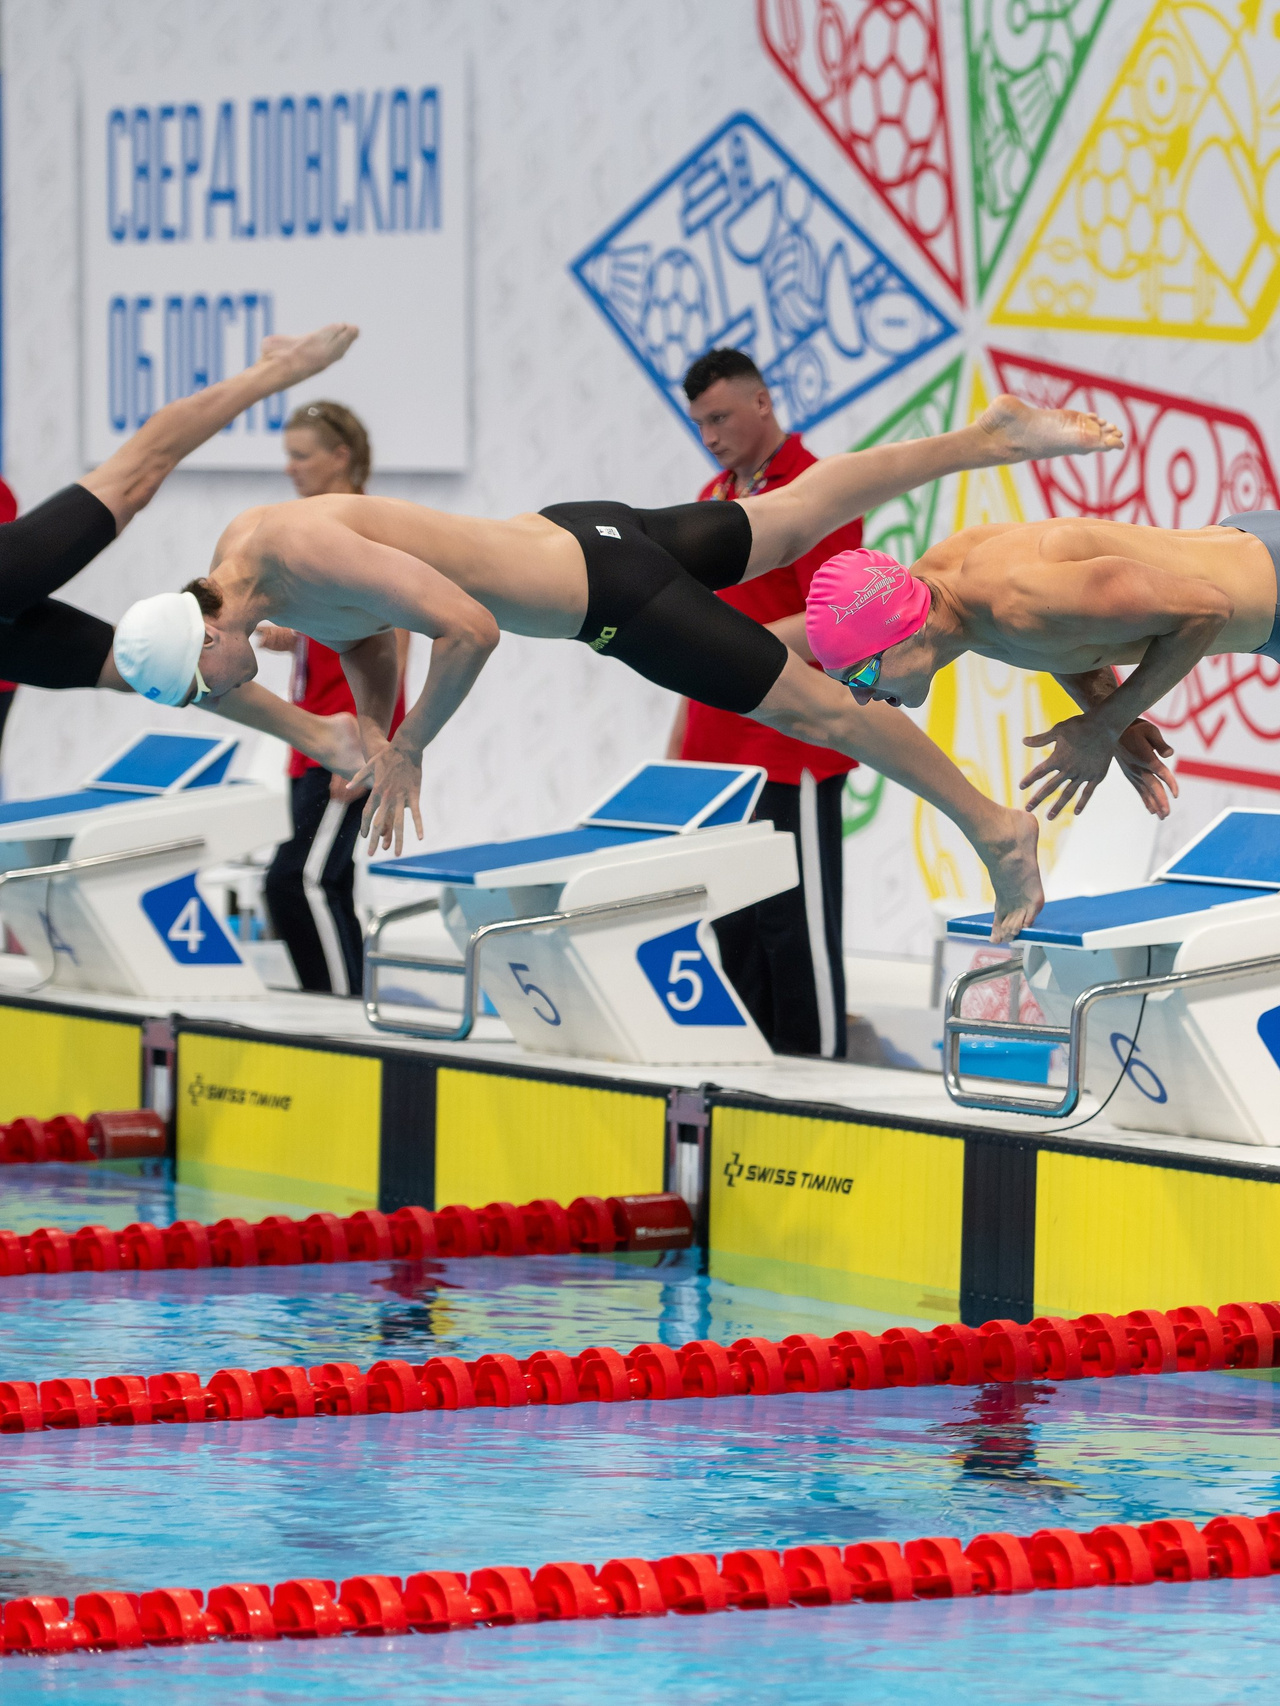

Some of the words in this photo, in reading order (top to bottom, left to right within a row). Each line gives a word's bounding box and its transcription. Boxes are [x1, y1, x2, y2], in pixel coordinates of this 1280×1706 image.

[107, 86, 443, 243] СВЕРДЛОВСКАЯ
[107, 294, 288, 434] ОБЛАСТЬ
[168, 897, 206, 954] 4
[508, 962, 562, 1027] 5
[666, 950, 703, 1012] 5
[207, 1084, 247, 1105] SWISS
[247, 1090, 293, 1112] TIMING
[1110, 1032, 1168, 1105] 6
[745, 1165, 797, 1187] SWISS
[800, 1172, 854, 1195] TIMING
